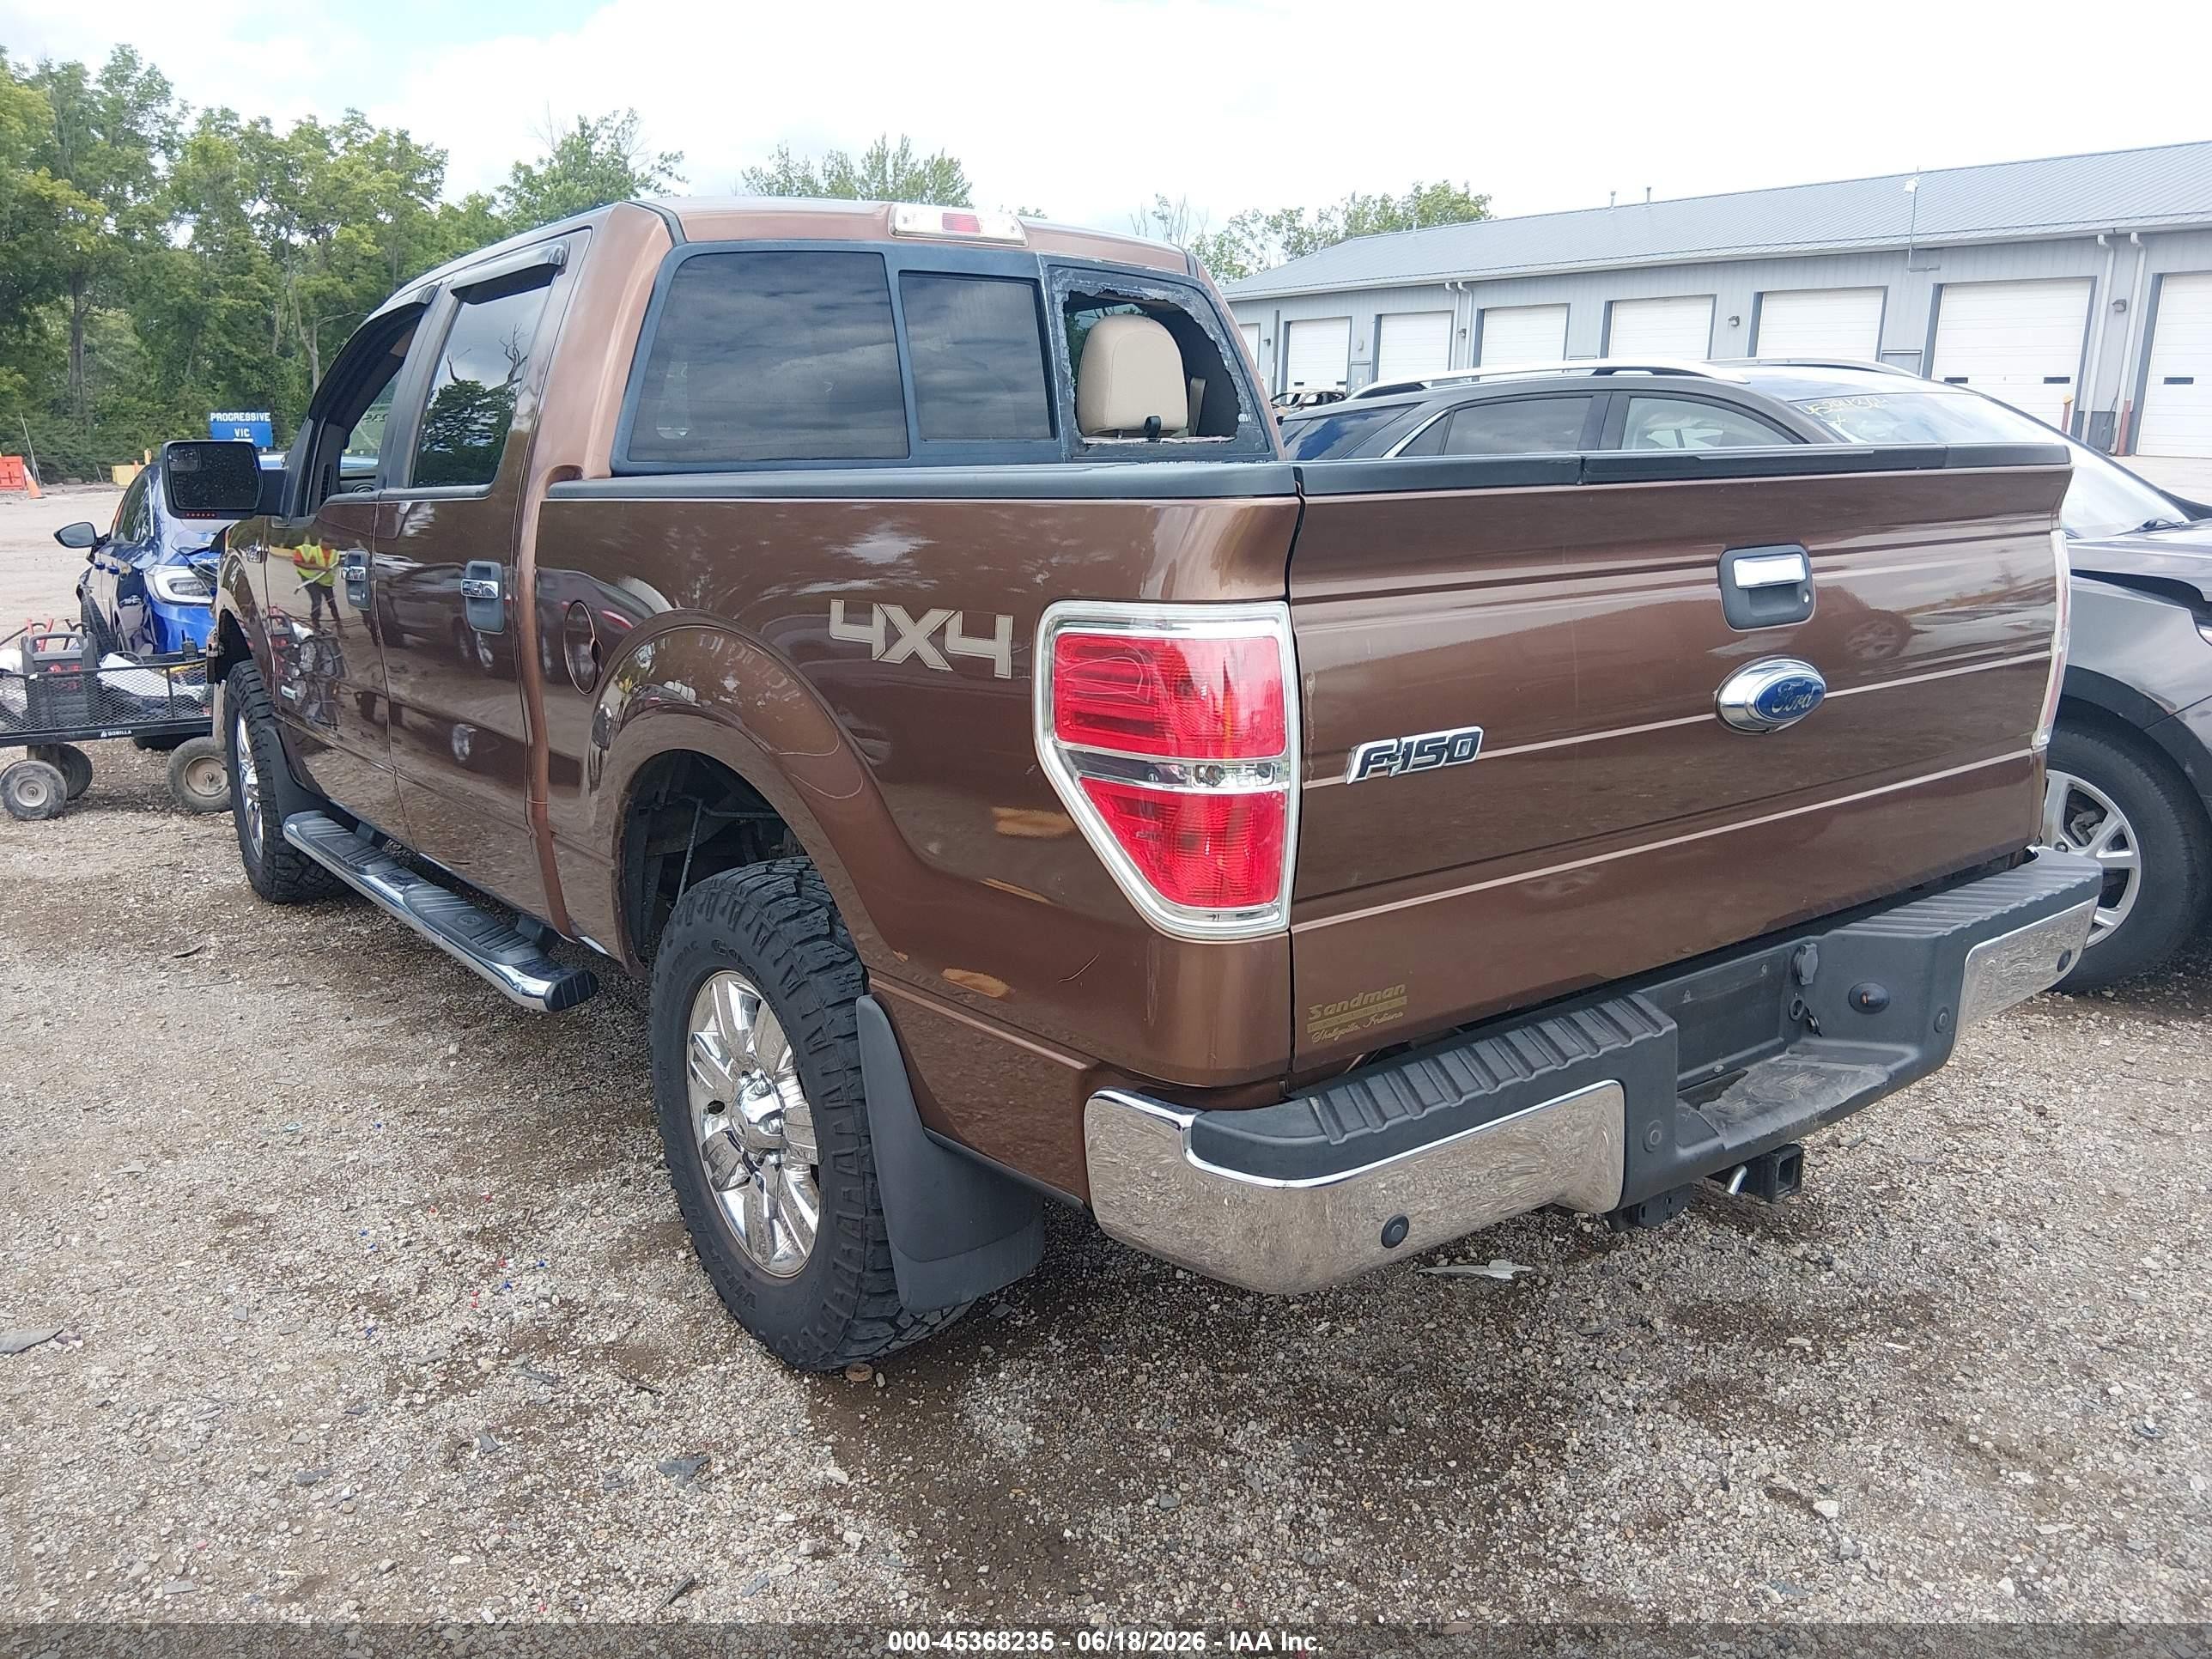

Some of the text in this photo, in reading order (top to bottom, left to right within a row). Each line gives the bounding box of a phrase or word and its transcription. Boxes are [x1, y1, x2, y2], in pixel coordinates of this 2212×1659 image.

[210, 411, 271, 422] PROGRESSIVE
[234, 428, 251, 438] VIC
[829, 598, 1014, 679] 4X4
[1771, 679, 1824, 714] Ford
[1346, 726, 1485, 785] F-150
[1308, 983, 1406, 1020] Sandman
